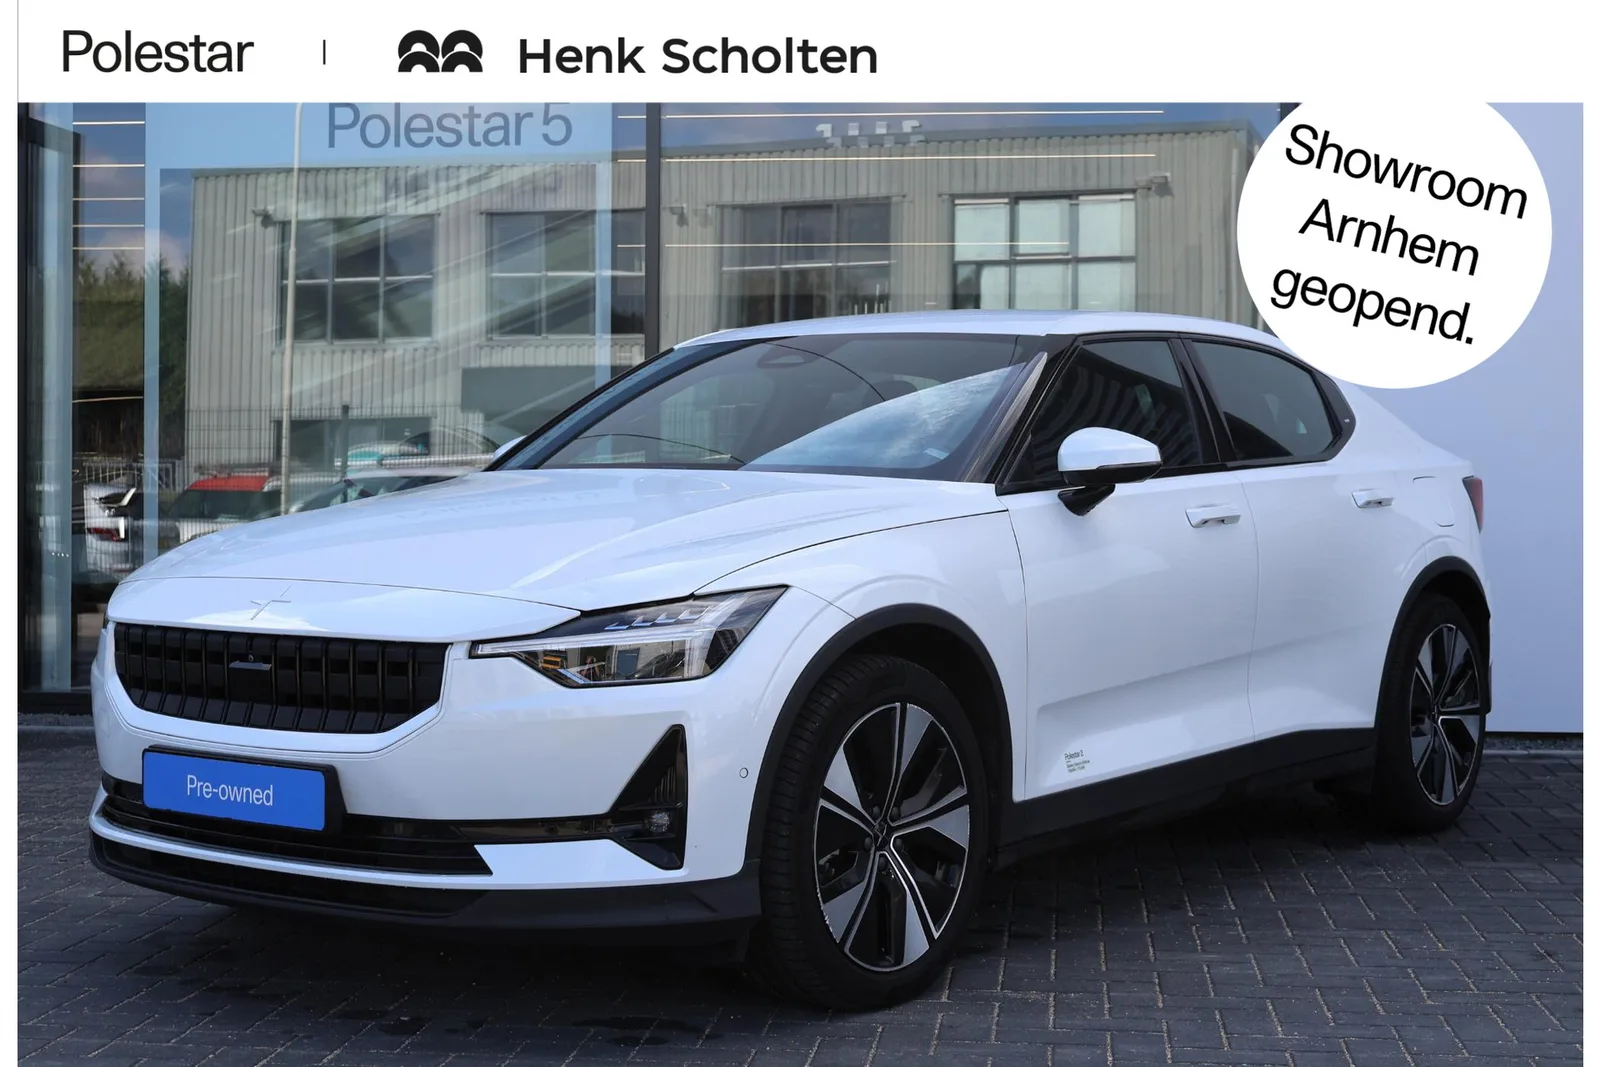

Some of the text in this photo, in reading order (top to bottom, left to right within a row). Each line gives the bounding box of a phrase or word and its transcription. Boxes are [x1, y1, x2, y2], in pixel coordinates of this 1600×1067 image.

[328, 103, 572, 149] Polestar 5
[186, 774, 274, 807] Pre-owned
